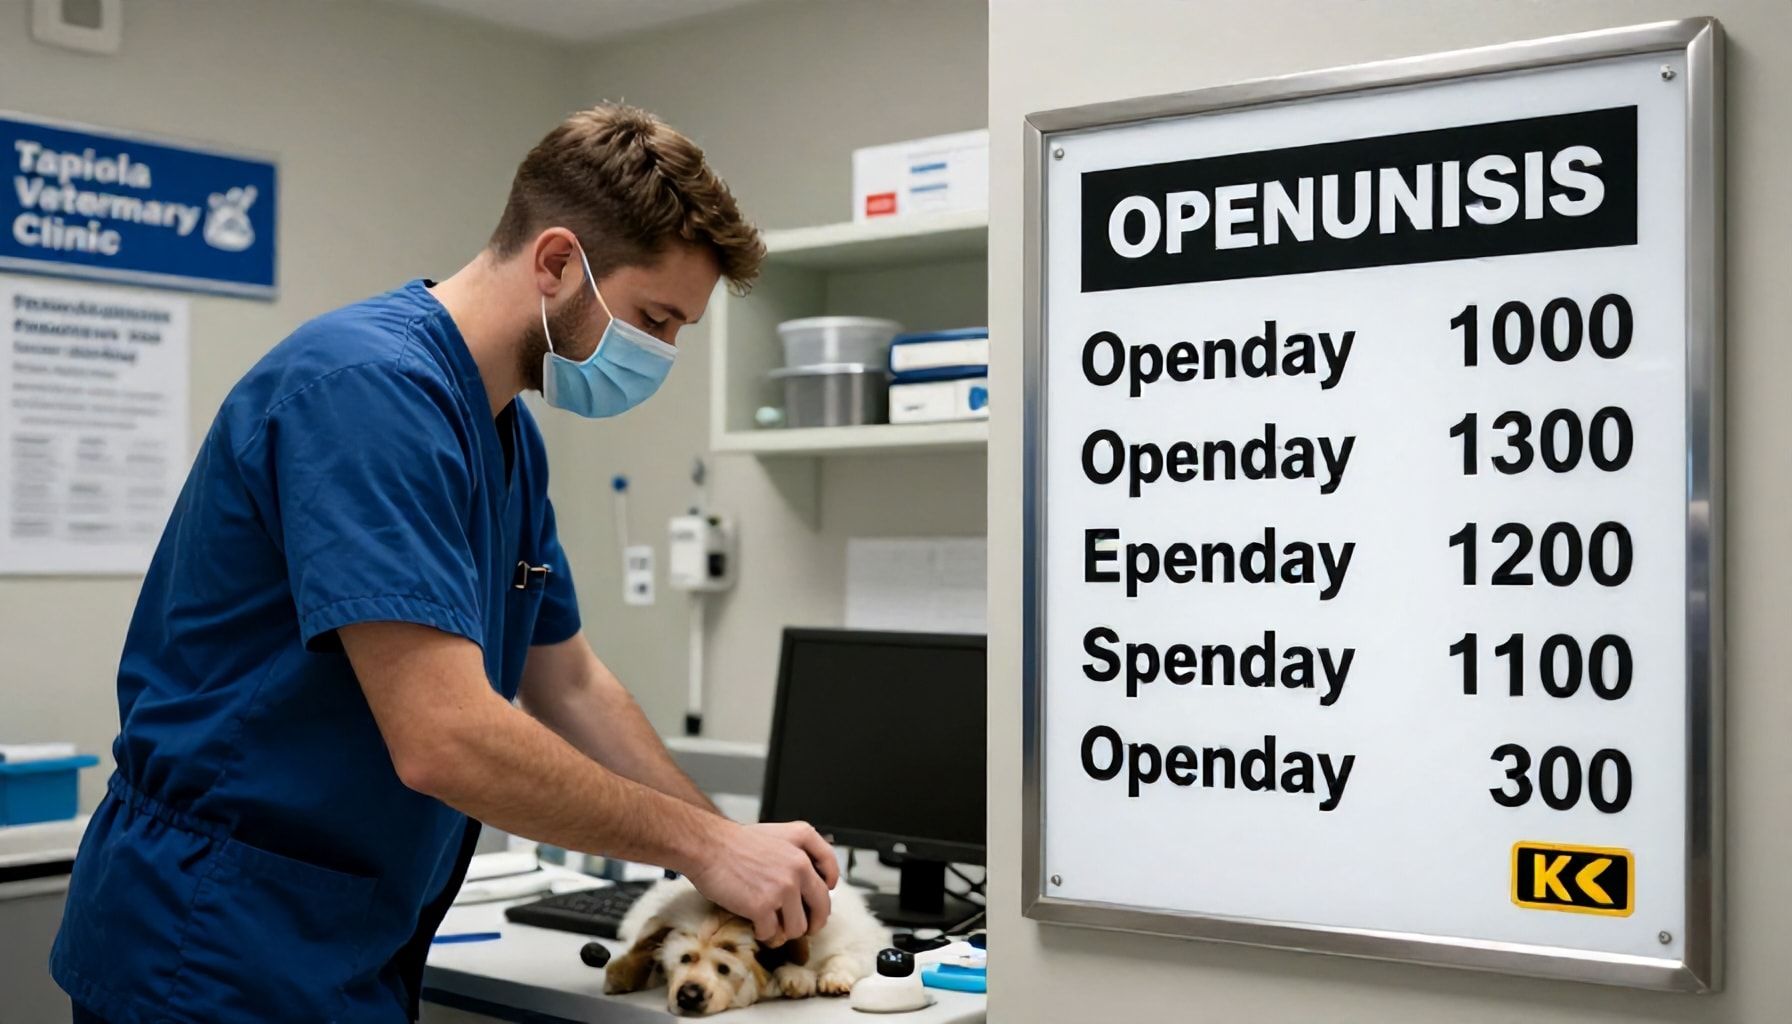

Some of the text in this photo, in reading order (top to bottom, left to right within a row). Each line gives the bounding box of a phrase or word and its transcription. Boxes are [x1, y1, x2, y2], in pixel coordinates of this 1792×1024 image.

[15, 140, 151, 188] Tapiola
[1107, 145, 1606, 259] OPENUNISIS
[12, 213, 122, 256] Clinic
[1082, 294, 1633, 397] Openday 1000
[1082, 406, 1633, 497] Openday 1300
[1084, 521, 1633, 600] Ependay 1200
[1082, 627, 1633, 706] Spenday 1100
[1081, 725, 1632, 813] Openday 300
